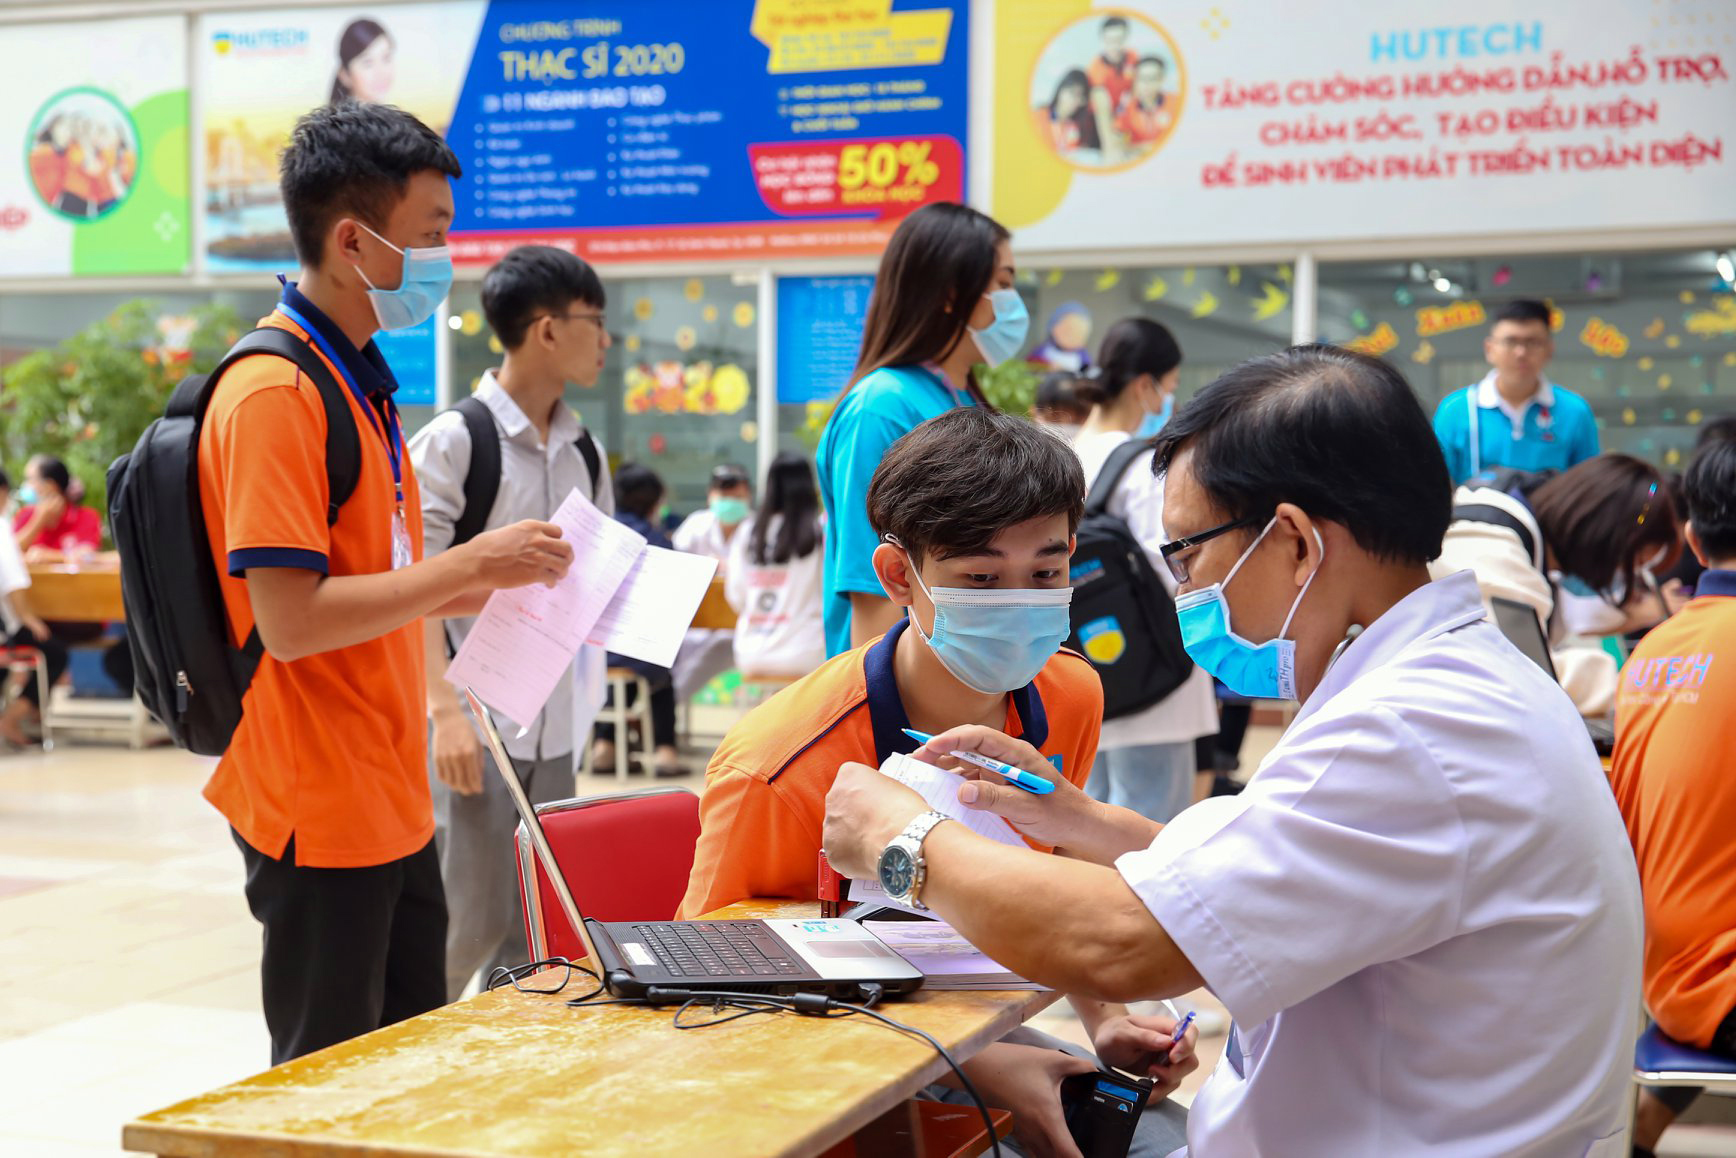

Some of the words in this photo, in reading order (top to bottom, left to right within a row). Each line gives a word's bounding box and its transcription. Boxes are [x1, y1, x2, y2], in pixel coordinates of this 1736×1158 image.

[1369, 21, 1543, 63] HUTECH
[499, 47, 577, 85] THẠC
[614, 42, 685, 77] 2020
[838, 140, 939, 189] 50%
[1243, 161, 1309, 187] SINH
